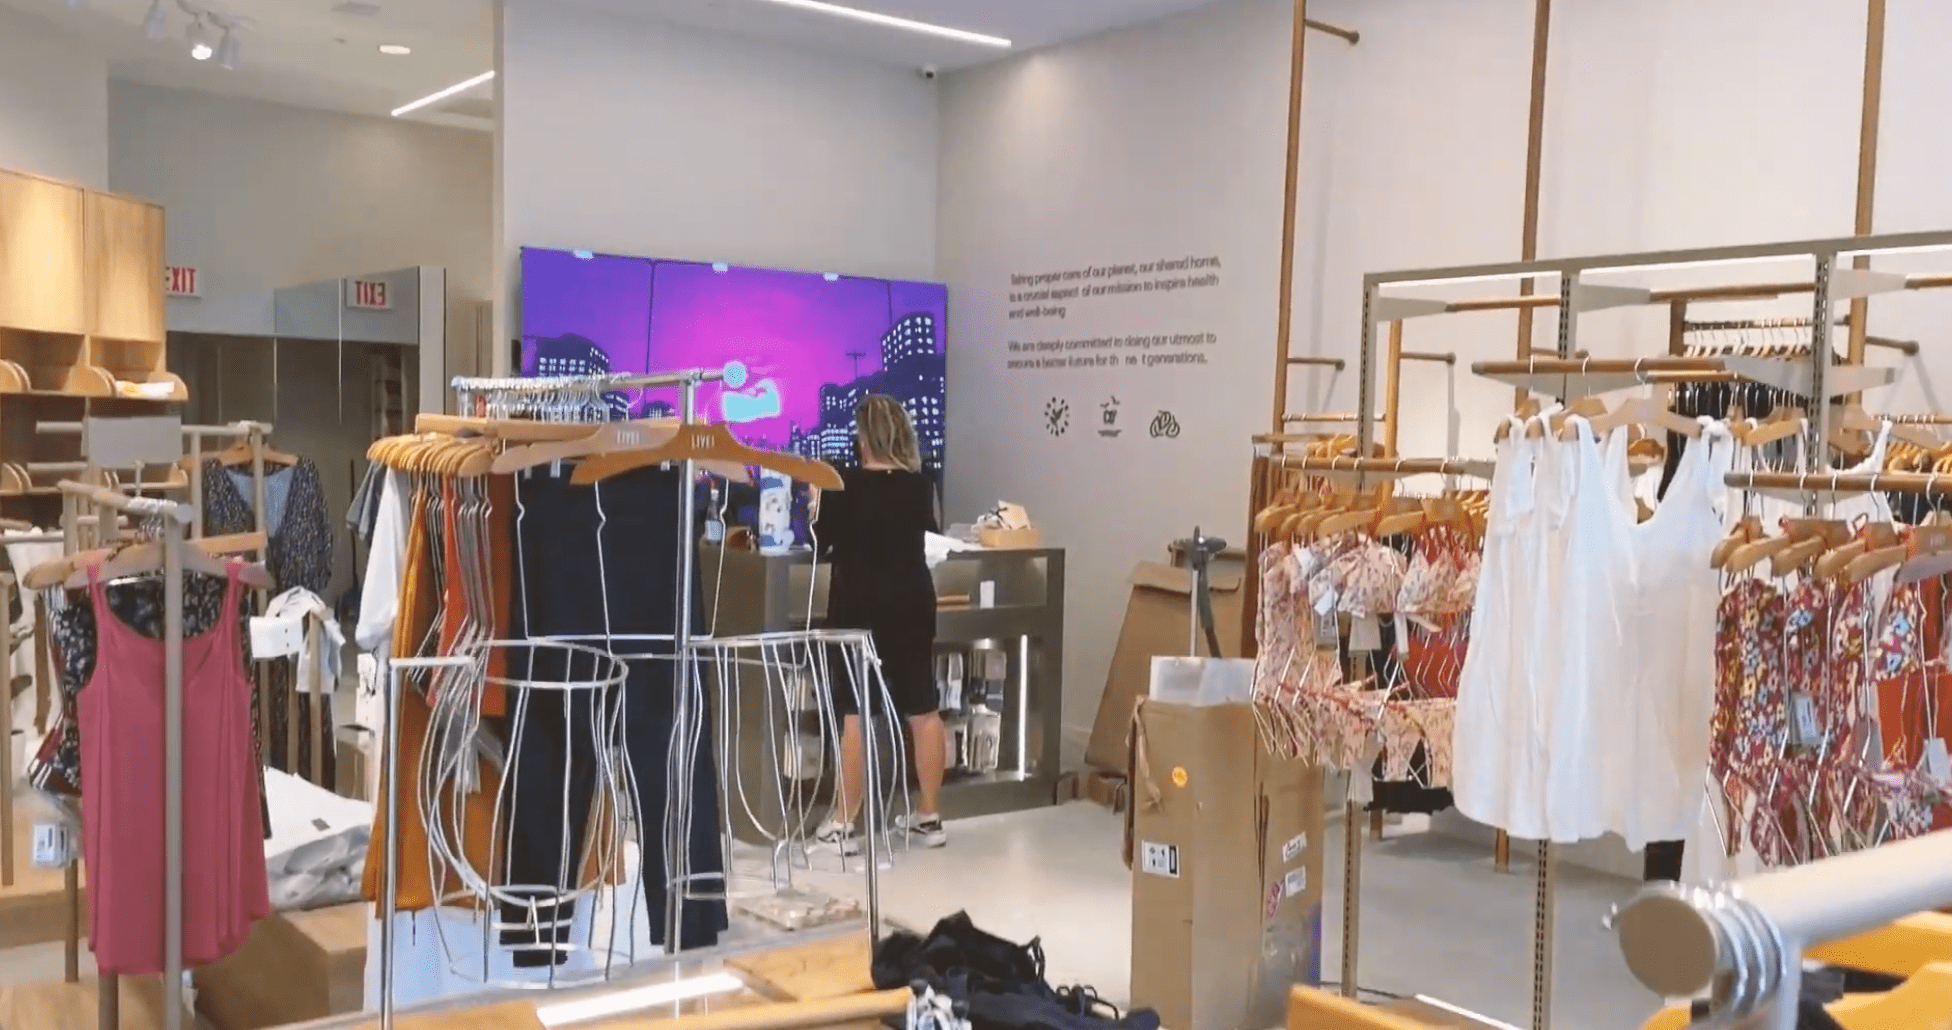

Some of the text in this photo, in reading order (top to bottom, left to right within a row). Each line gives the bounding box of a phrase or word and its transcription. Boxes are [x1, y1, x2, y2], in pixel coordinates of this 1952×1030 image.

[1062, 270, 1082, 279] care
[1082, 265, 1092, 278] of
[1092, 267, 1106, 277] our
[1139, 262, 1154, 272] our
[1156, 256, 1188, 271] shared
[1082, 284, 1091, 297] of
[1092, 286, 1106, 296] our
[1108, 282, 1142, 294] mission
[1144, 281, 1153, 291] to
[1154, 278, 1186, 292] inspire
[1188, 274, 1220, 286] health
[1009, 308, 1024, 320] and
[1008, 332, 1217, 352] We are deeply committed to doing our utmost to
[1096, 354, 1107, 366] for
